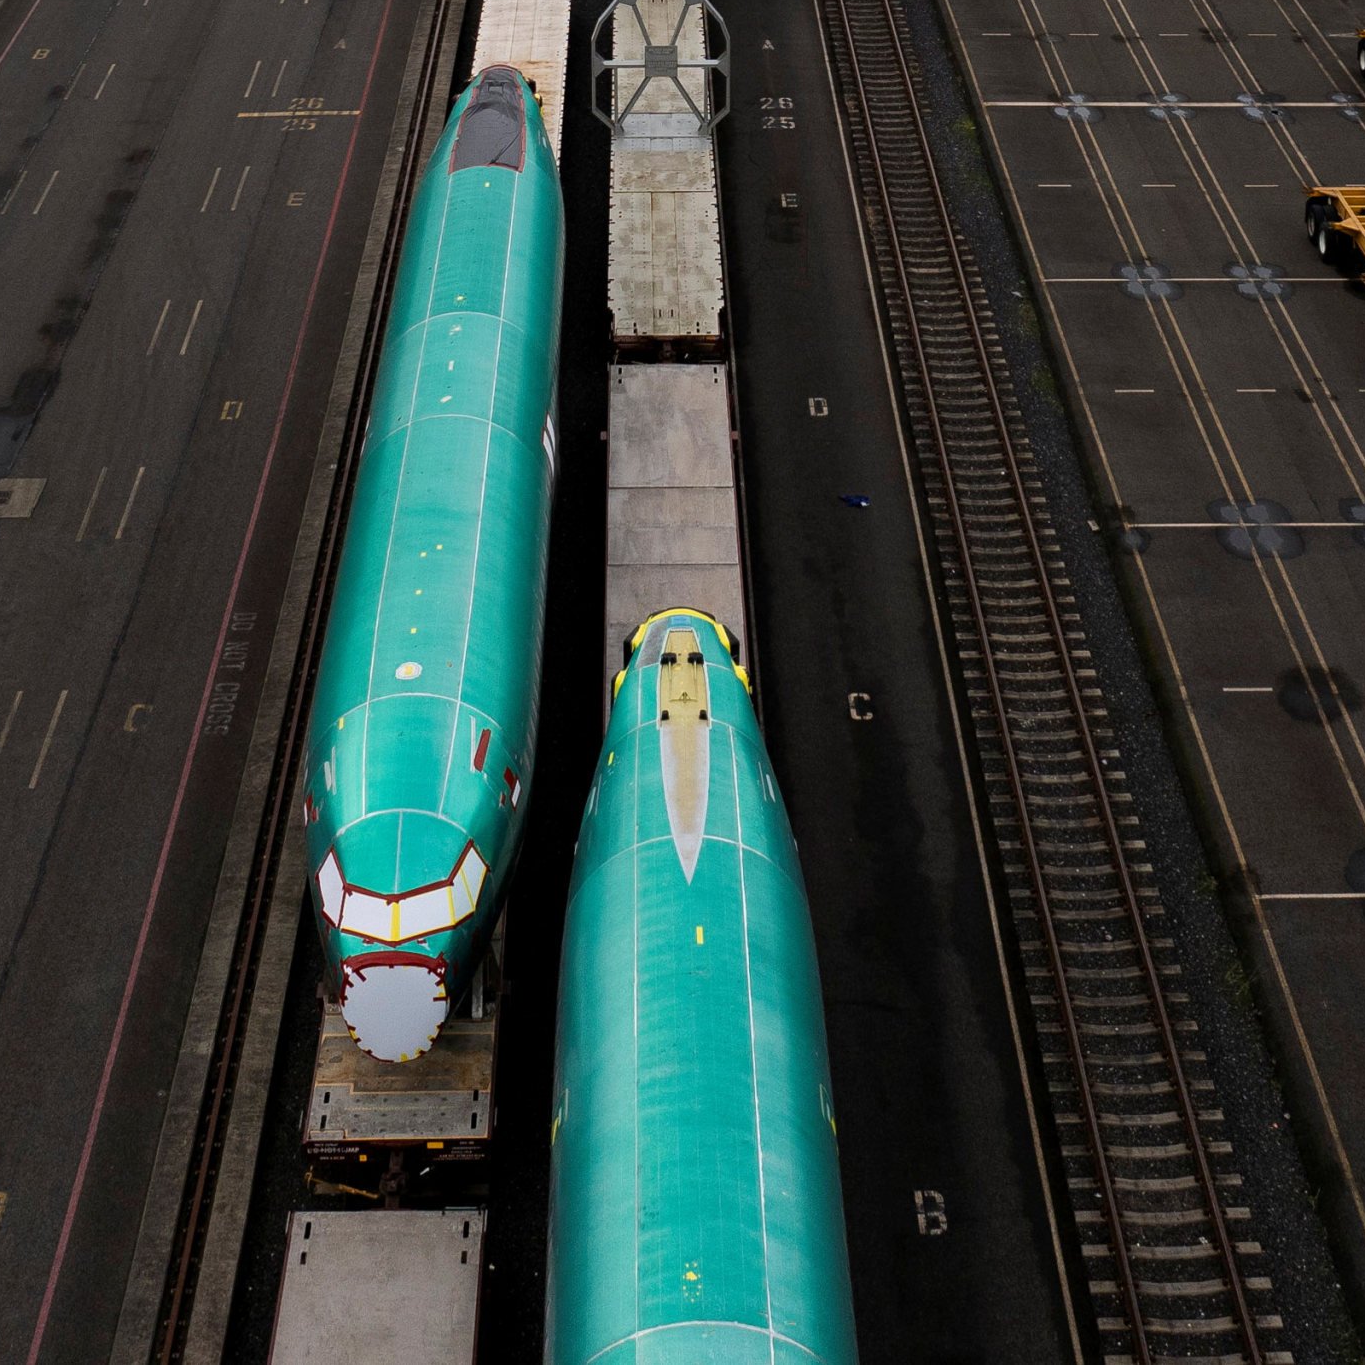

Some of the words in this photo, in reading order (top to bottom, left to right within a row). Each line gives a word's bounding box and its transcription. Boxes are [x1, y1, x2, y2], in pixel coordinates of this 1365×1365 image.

[333, 38, 347, 50] A
[762, 39, 775, 51] A
[31, 48, 51, 60] B
[289, 97, 325, 110] 26
[760, 97, 794, 110] 26
[285, 116, 319, 131] 25
[762, 115, 796, 130] 25
[286, 191, 307, 207] E
[780, 193, 799, 208] E
[220, 400, 244, 421] D
[808, 397, 829, 417] D
[220, 641, 250, 672] NOT
[204, 681, 241, 736] CROSS
[847, 692, 874, 721] C
[122, 703, 154, 733] C
[914, 1189, 948, 1236] B
